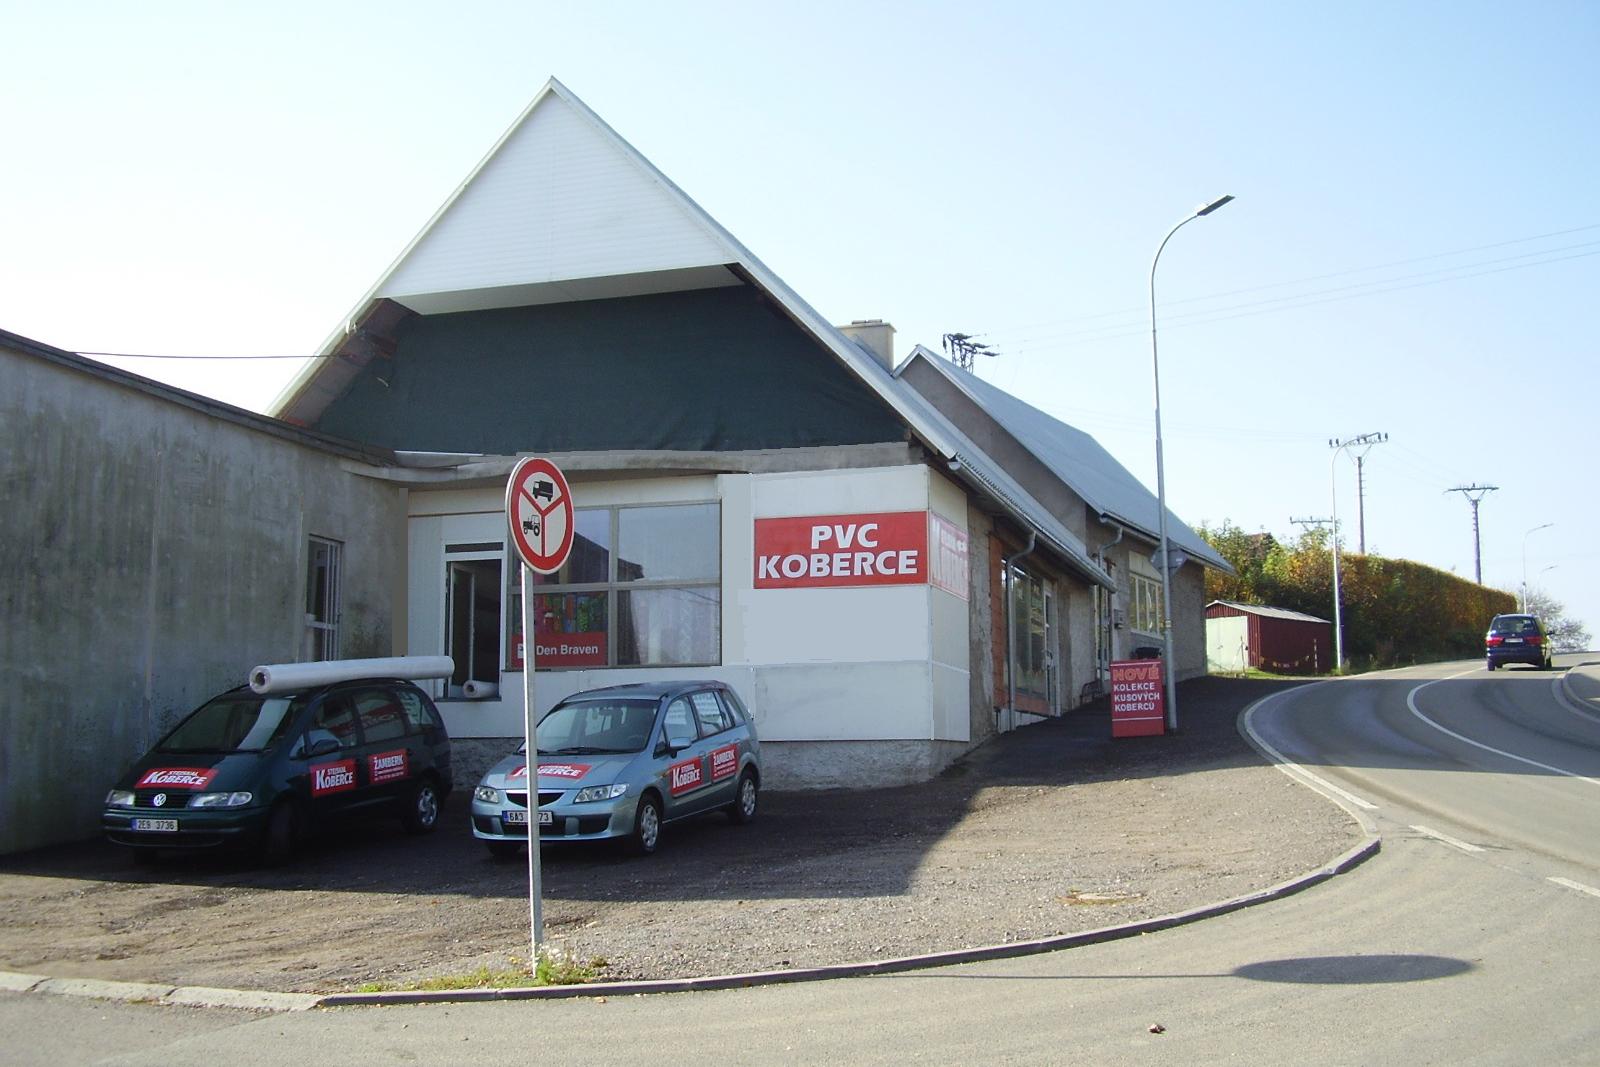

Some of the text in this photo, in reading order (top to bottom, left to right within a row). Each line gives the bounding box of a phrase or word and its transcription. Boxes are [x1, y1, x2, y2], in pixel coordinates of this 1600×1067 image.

[811, 523, 879, 550] PVC
[758, 550, 918, 579] KOBERCE
[536, 644, 598, 655] Den Braven
[1112, 664, 1160, 681] NOVÉ
[1113, 682, 1155, 692] KOLEKCE
[1114, 691, 1160, 702] KUSOVÝCH
[143, 770, 207, 785] KOBERCE
[316, 769, 353, 790] KOBERCE
[509, 812, 524, 821] 6A3
